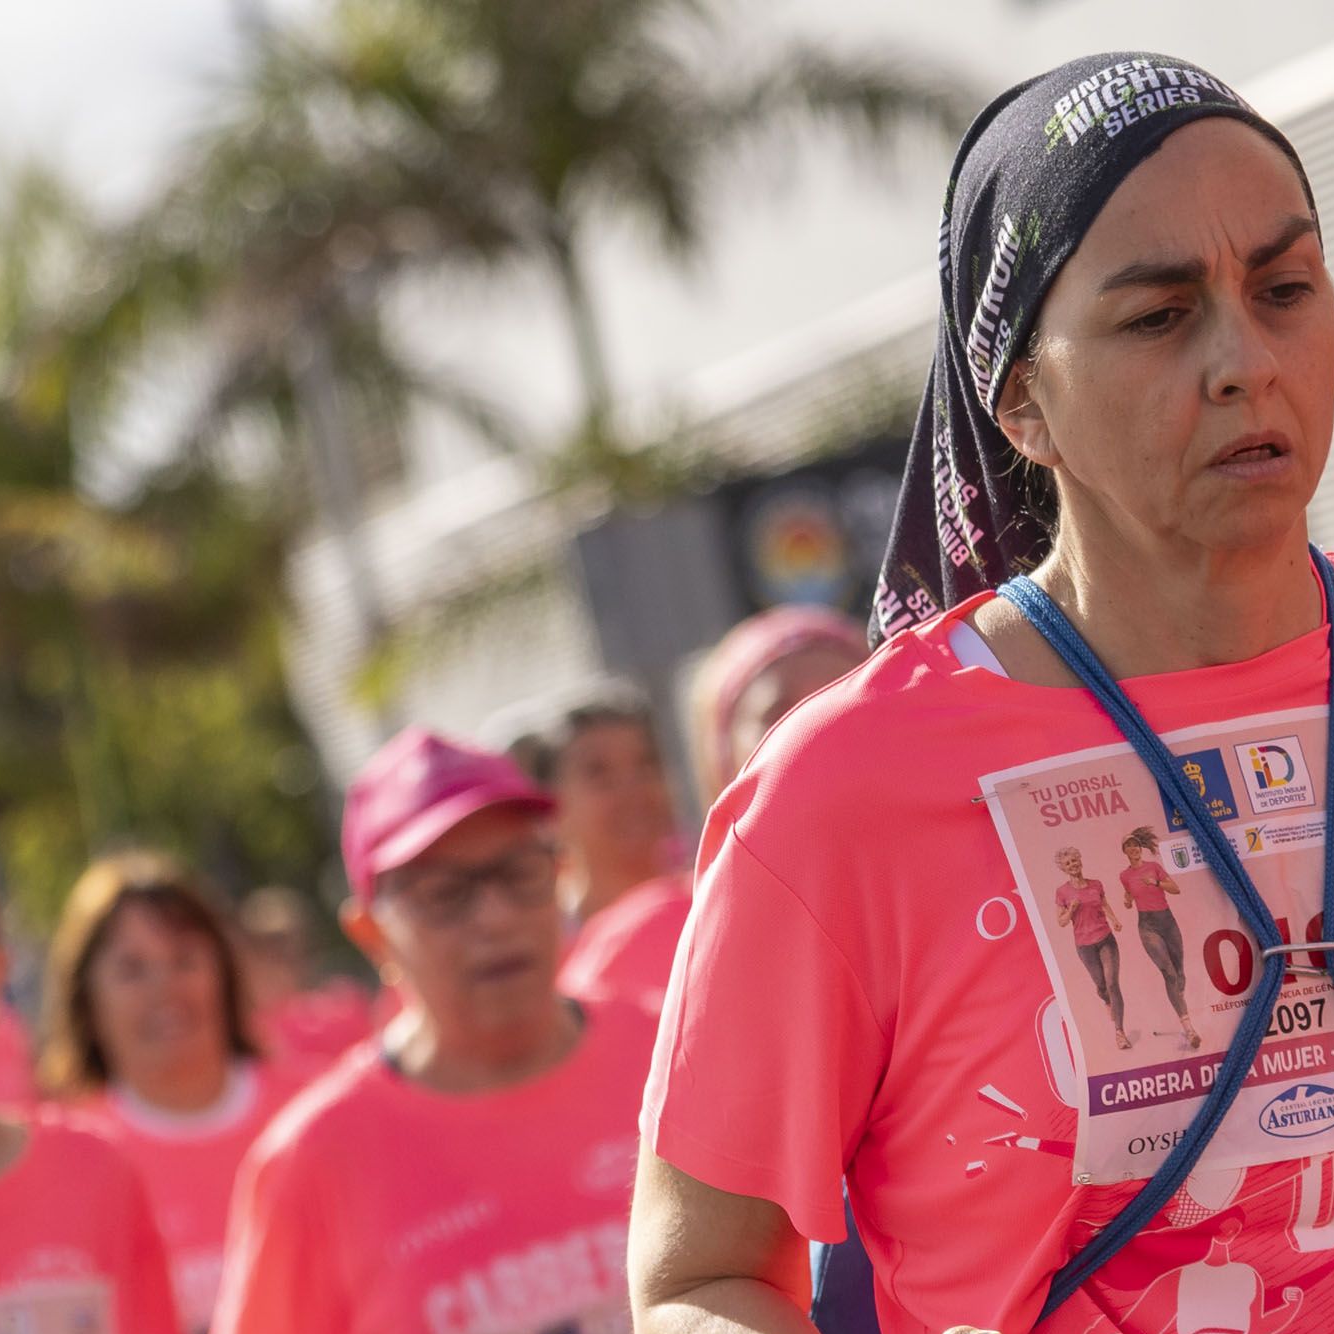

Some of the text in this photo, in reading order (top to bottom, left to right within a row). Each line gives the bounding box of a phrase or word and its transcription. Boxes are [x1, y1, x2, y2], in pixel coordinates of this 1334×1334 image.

[1054, 59, 1152, 116] BINTER
[1103, 87, 1201, 138] SERIES
[1029, 773, 1122, 804] TU DORSAL
[1269, 792, 1307, 808] DEPORTES
[1040, 790, 1130, 827] SUMA
[1211, 997, 1253, 1013] TELÉFON
[1303, 985, 1314, 995] DE
[1100, 1069, 1195, 1106] CARRERA
[1262, 1044, 1327, 1076] MUJER
[1127, 1128, 1188, 1156] OYSH
